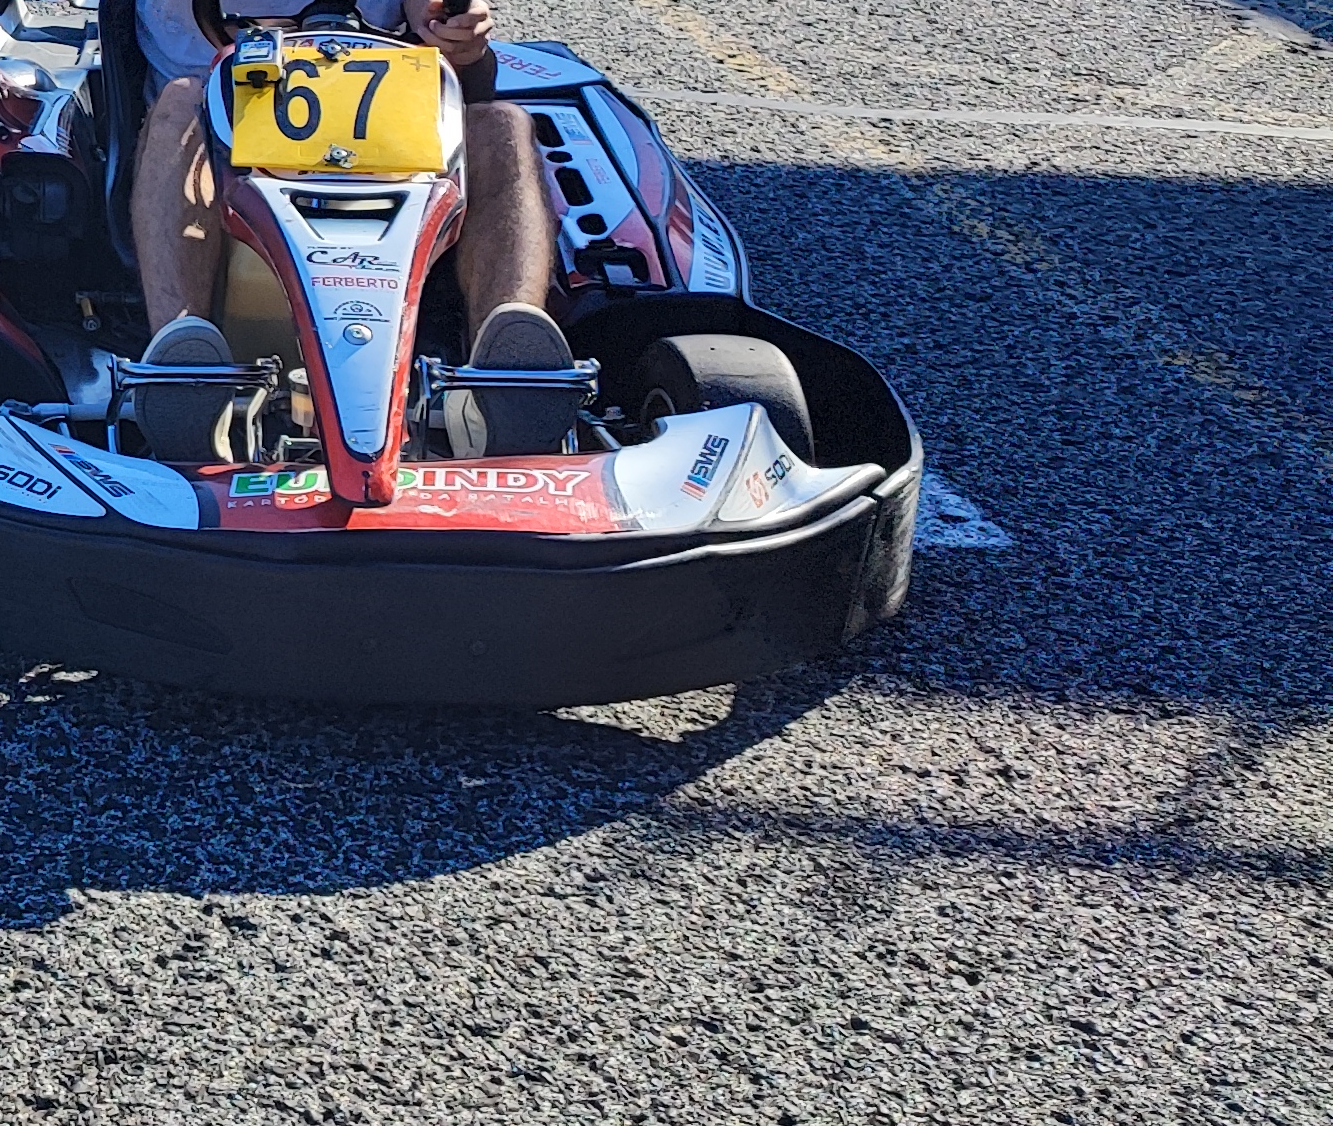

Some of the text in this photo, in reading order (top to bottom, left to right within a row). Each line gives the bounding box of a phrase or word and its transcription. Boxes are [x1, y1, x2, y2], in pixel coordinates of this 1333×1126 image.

[494, 50, 562, 81] FERB
[273, 59, 391, 141] 67
[310, 276, 399, 290] FERBERTO
[228, 467, 592, 498] EUOINDY
